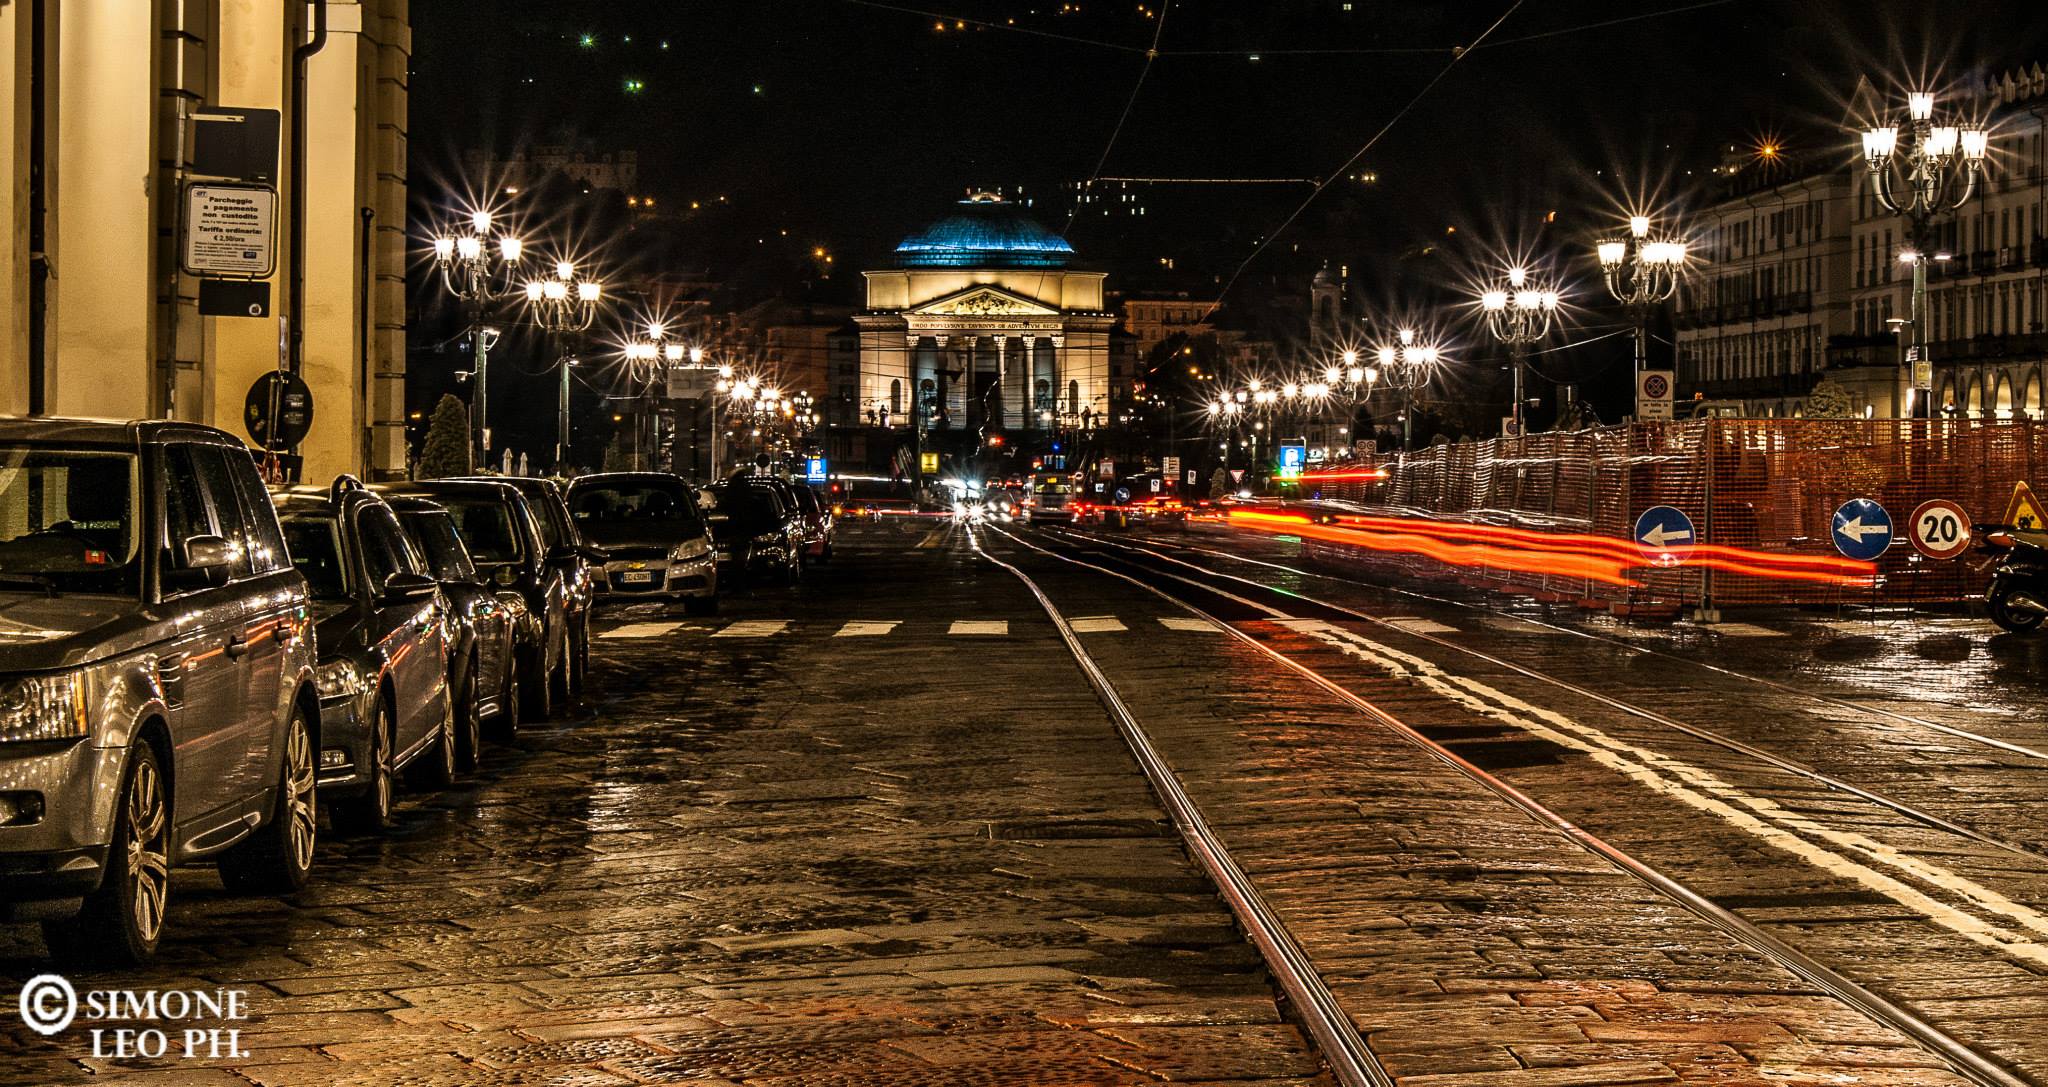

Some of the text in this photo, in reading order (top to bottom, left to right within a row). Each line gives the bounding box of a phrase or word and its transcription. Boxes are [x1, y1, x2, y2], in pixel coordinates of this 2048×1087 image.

[209, 197, 253, 205] Parcheggio
[221, 212, 258, 220] custodito
[198, 225, 262, 235] Tariffa ordinaria:
[1923, 515, 1958, 543] 20
